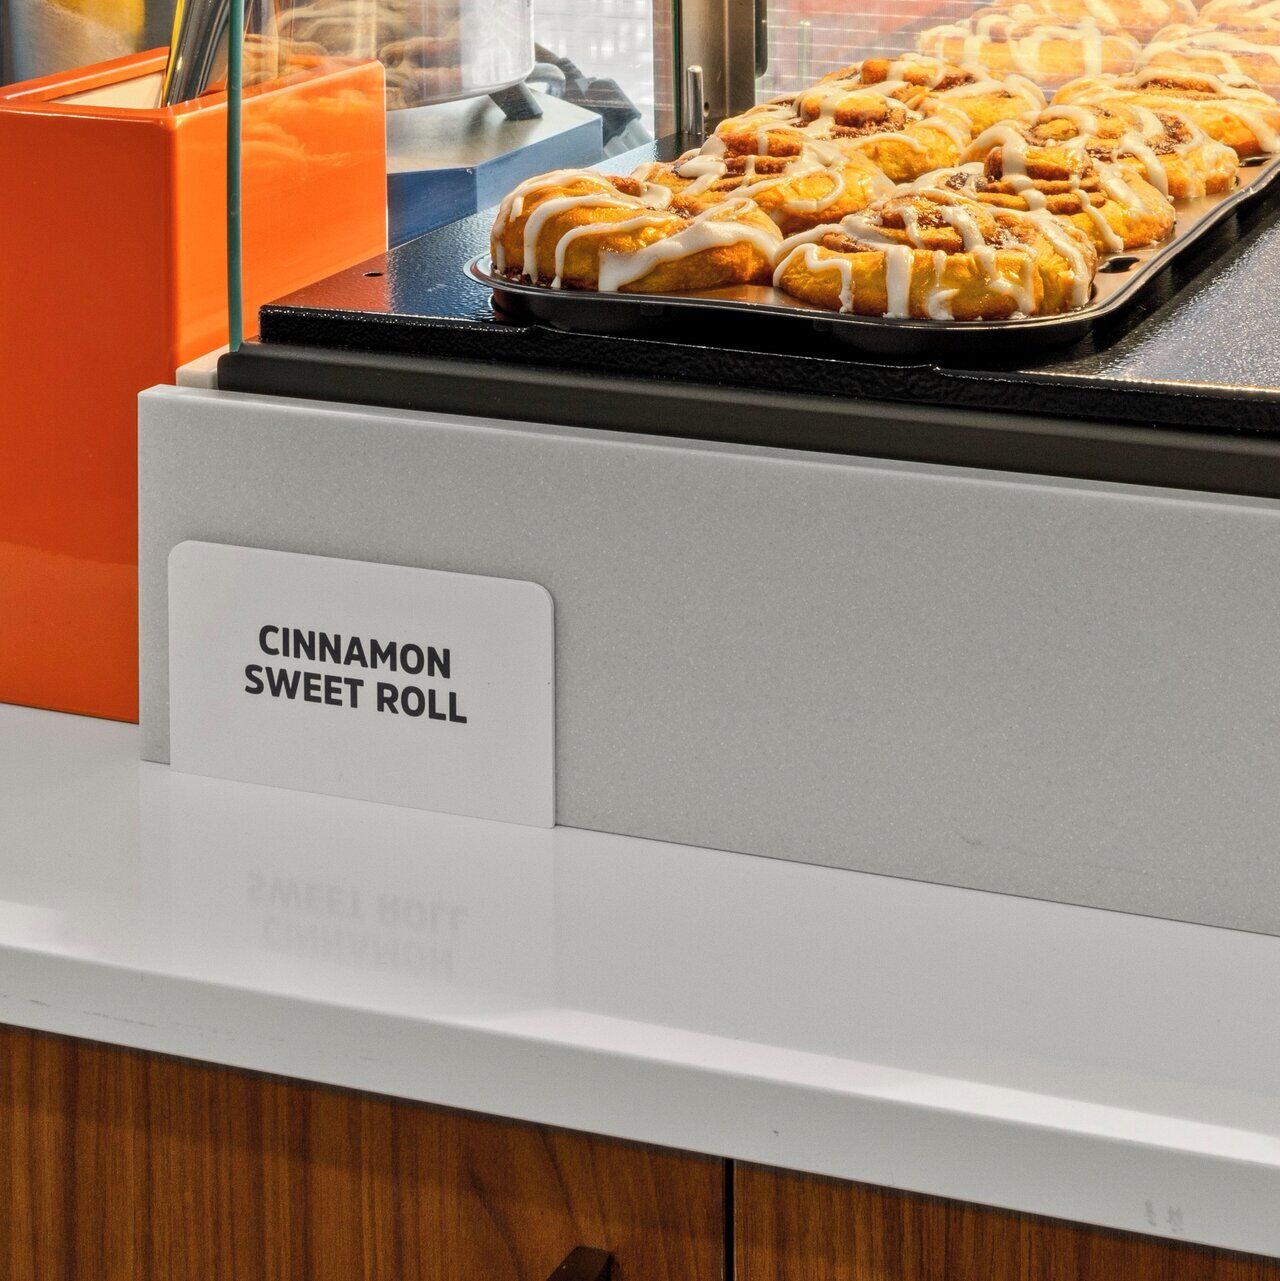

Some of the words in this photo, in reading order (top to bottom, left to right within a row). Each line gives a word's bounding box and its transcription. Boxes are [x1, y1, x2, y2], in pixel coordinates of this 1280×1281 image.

[258, 624, 452, 680] CINNAMON
[244, 663, 365, 709] SWEET
[376, 681, 469, 725] ROLL
